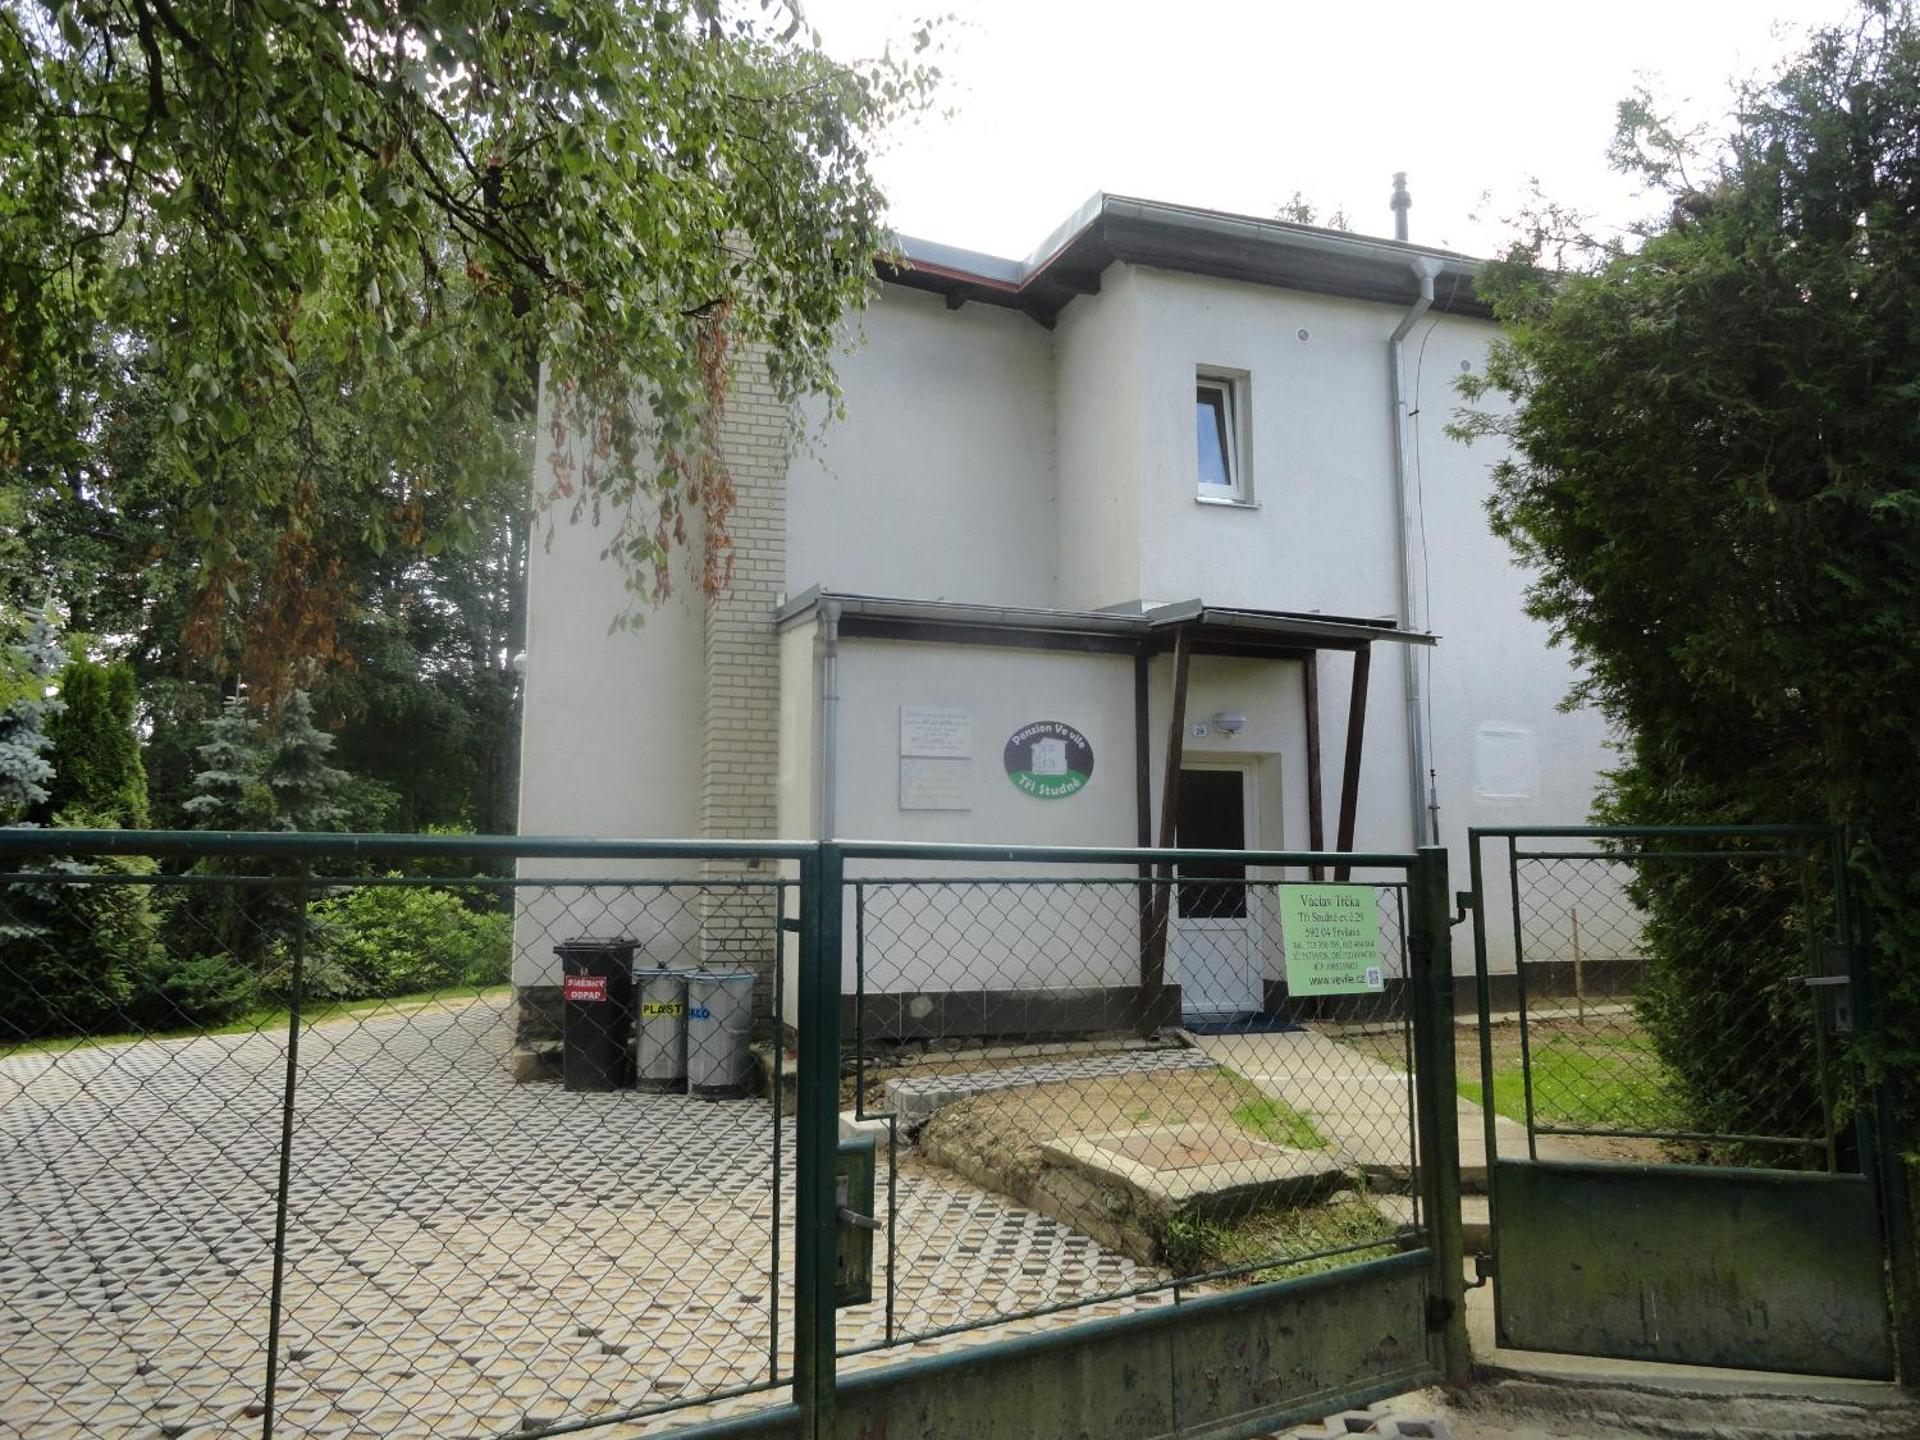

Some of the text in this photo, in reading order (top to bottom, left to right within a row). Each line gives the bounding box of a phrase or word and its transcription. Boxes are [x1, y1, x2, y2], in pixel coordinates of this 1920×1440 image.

[1300, 894, 1332, 907] Václav
[570, 991, 601, 999] ODPAD
[643, 1003, 682, 1015] PLAST
